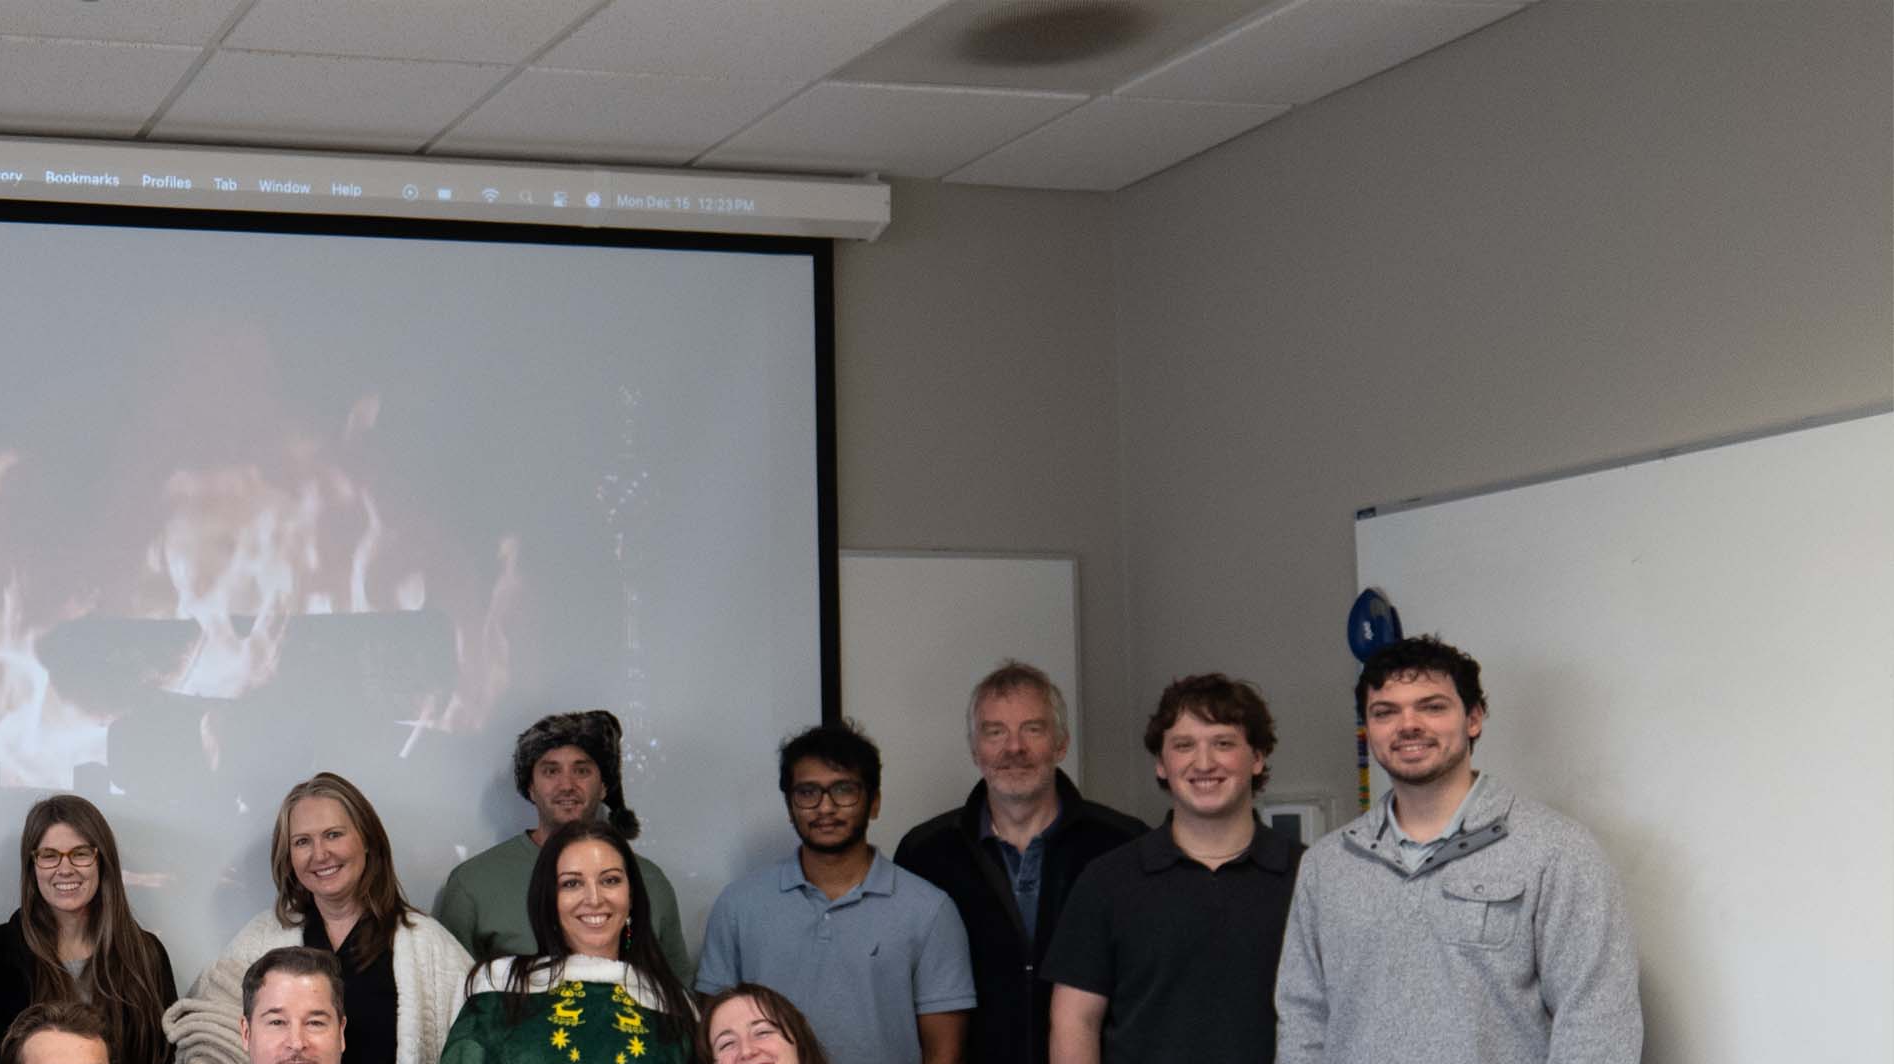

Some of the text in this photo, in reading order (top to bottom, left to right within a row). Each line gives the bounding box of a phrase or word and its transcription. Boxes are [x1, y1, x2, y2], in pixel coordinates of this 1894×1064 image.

[44, 170, 120, 187] Bookmarks
[141, 173, 192, 190] Profiles
[213, 177, 238, 191] Tab
[258, 179, 311, 194] Window
[331, 183, 362, 198] Help
